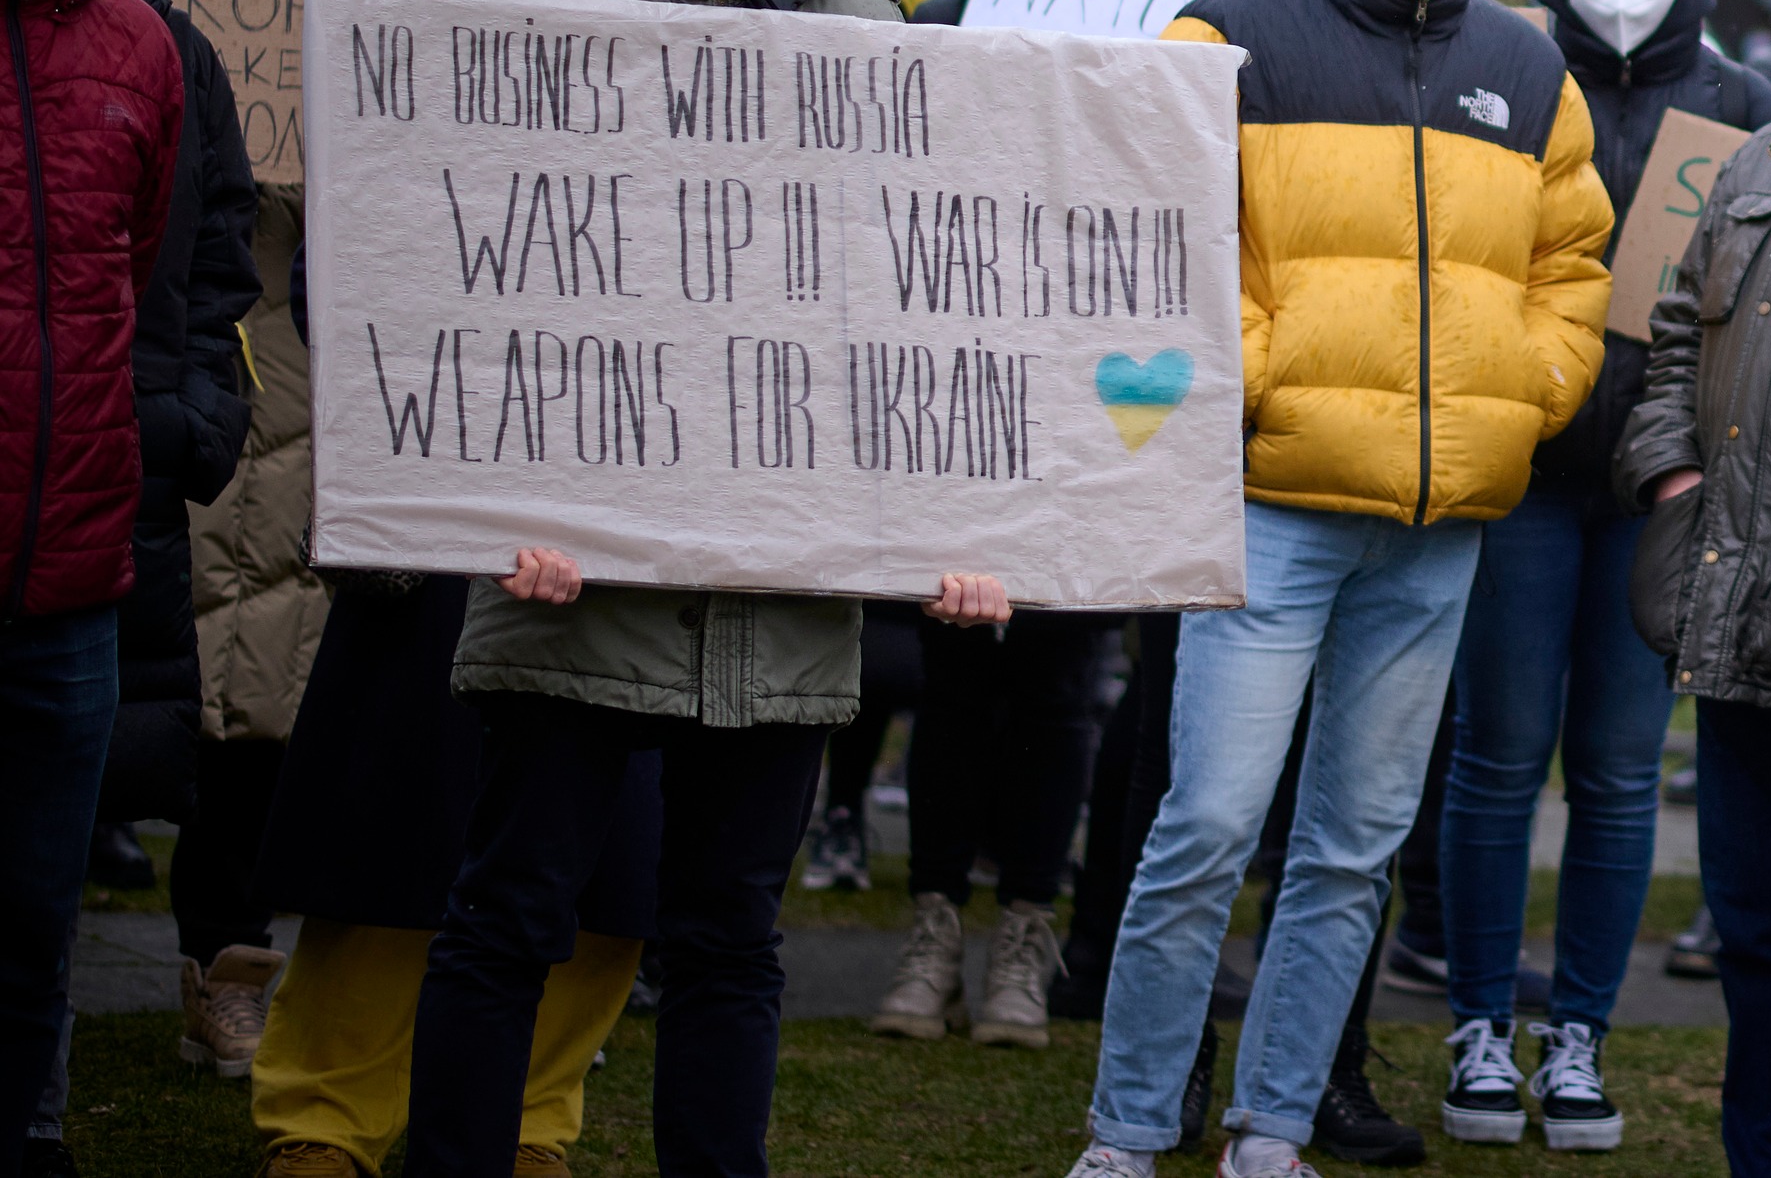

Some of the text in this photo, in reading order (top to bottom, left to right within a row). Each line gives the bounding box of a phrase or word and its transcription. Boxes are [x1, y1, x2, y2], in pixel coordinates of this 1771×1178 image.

[352, 23, 415, 121] NO
[1475, 86, 1497, 103] THE
[1459, 94, 1497, 114] NORTH
[1470, 106, 1496, 124] FACE
[443, 168, 641, 298] WAKE
[680, 178, 753, 303] UP
[882, 184, 1001, 318] WAR
[367, 322, 680, 467] WEAPONS
[727, 335, 815, 470] FOR
